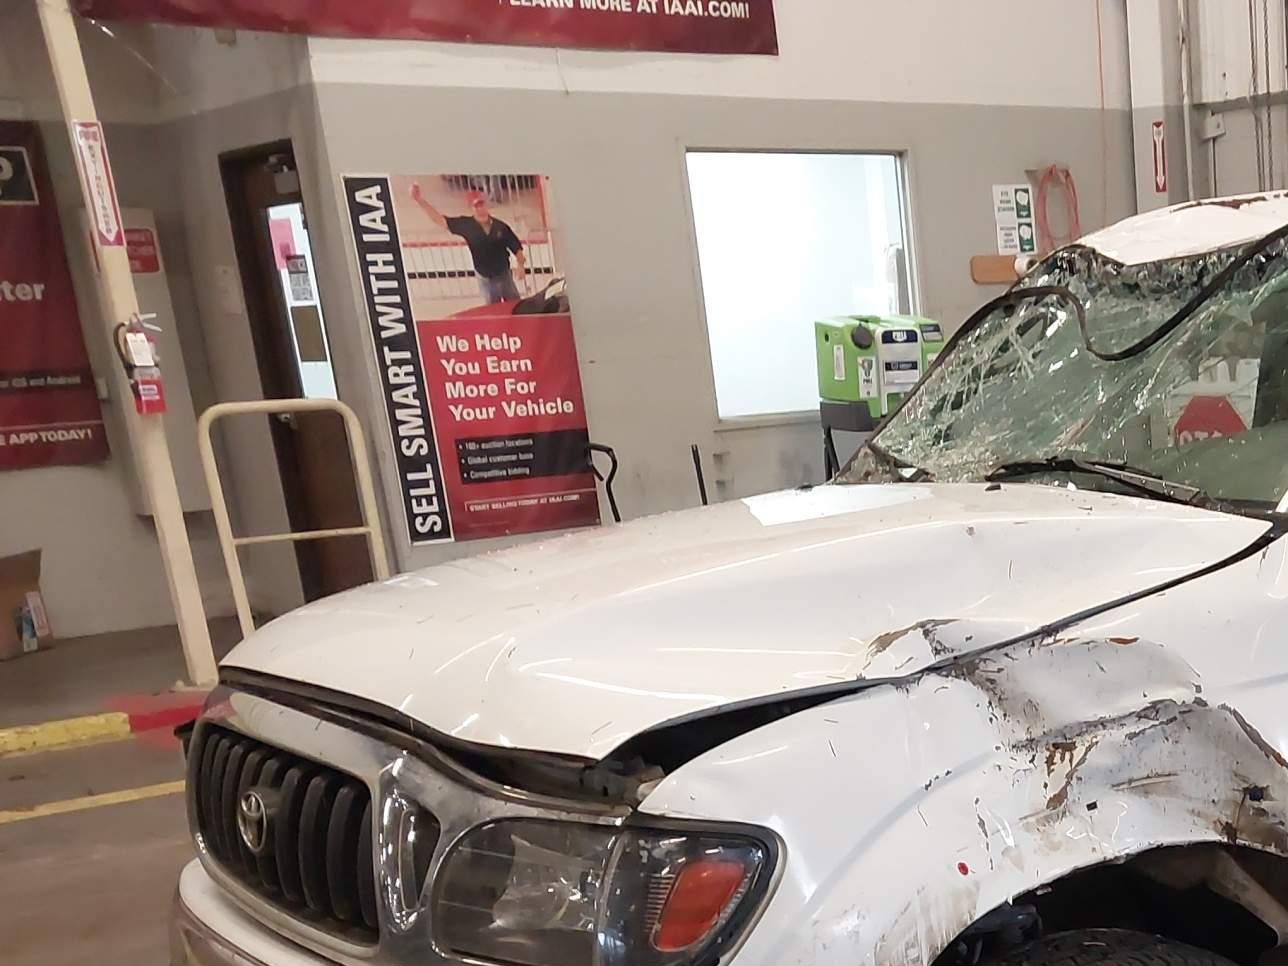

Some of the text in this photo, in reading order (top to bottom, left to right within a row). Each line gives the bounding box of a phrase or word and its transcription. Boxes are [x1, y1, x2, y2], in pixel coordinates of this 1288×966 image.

[637, 0, 659, 14] AT
[436, 333, 522, 353] We Help
[354, 184, 442, 534] SELL SMART WITH IAA
[440, 356, 533, 376] You Earn
[444, 378, 537, 399] More For
[448, 397, 574, 421] Your Vehicle
[9, 432, 38, 446] APP
